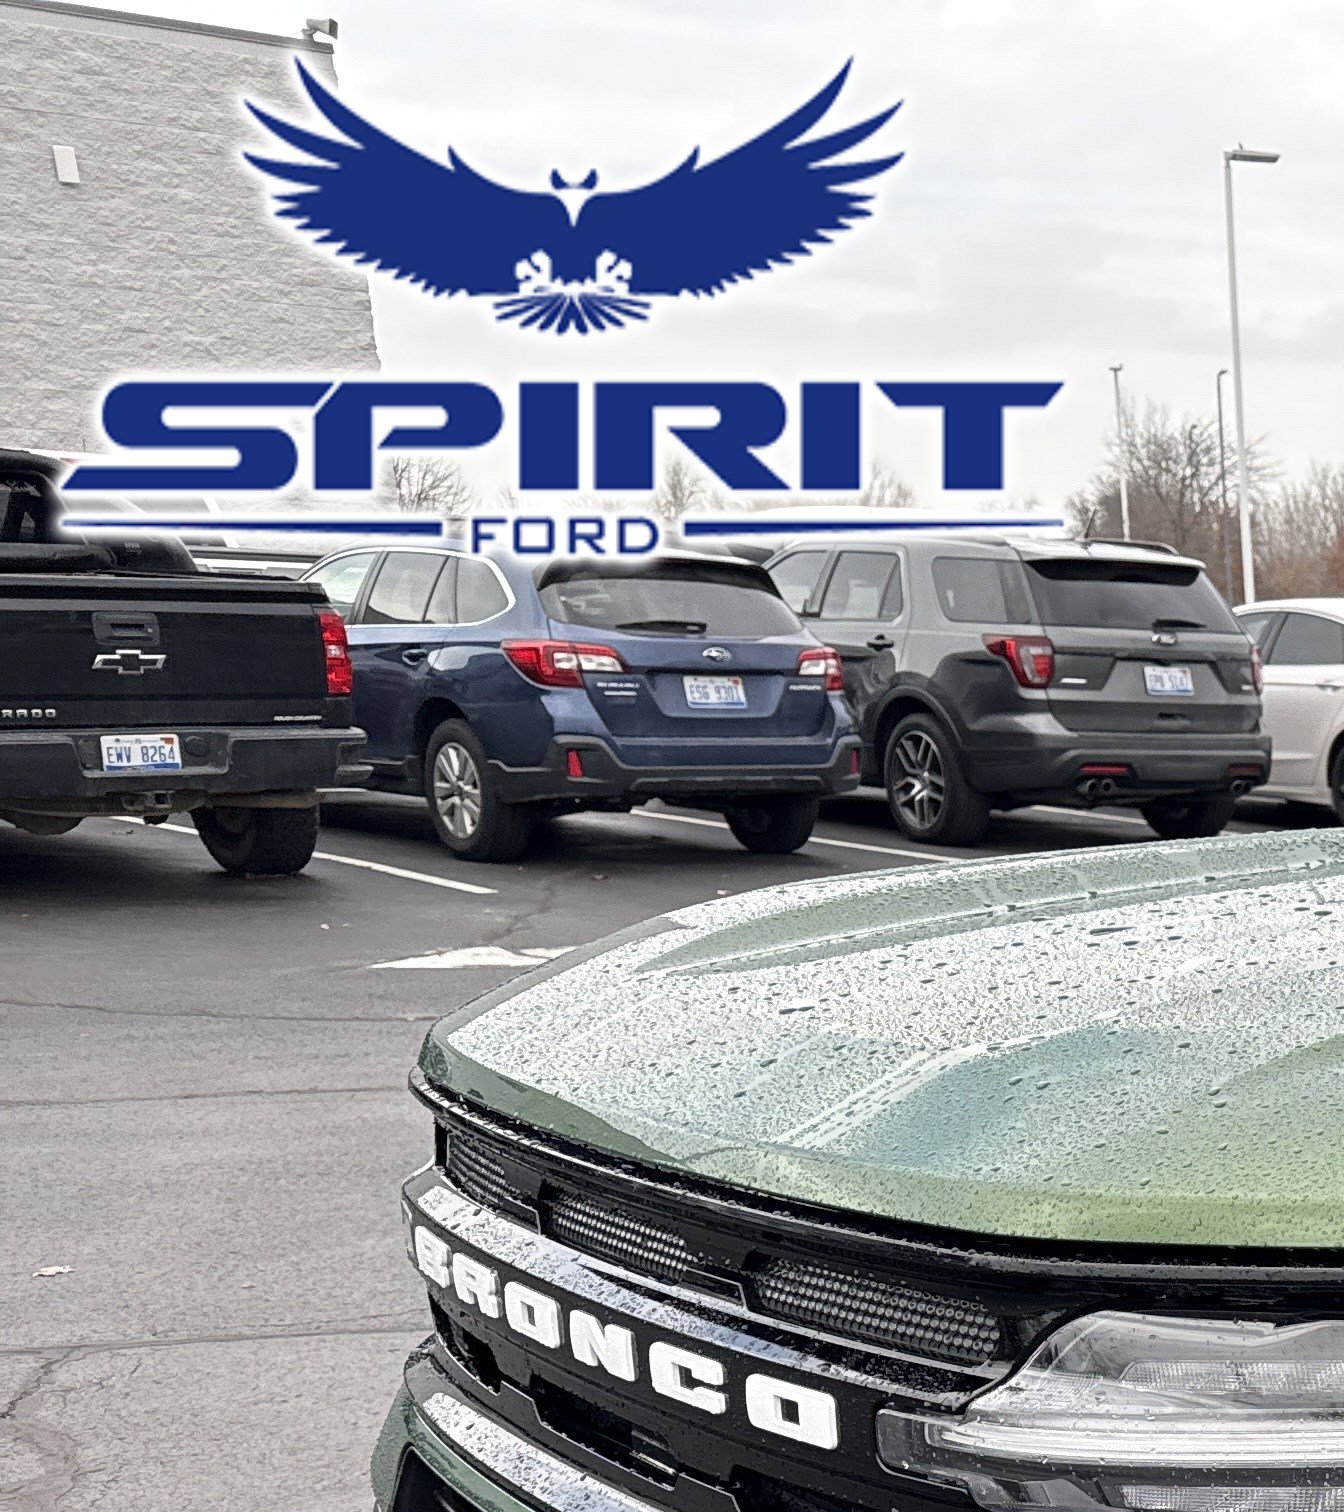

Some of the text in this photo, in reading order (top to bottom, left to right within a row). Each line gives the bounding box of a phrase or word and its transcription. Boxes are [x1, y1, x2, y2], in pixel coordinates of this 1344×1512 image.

[1, 708, 57, 719] RADO
[106, 745, 176, 764] EWV 8264
[414, 1224, 841, 1451] BRONCO
